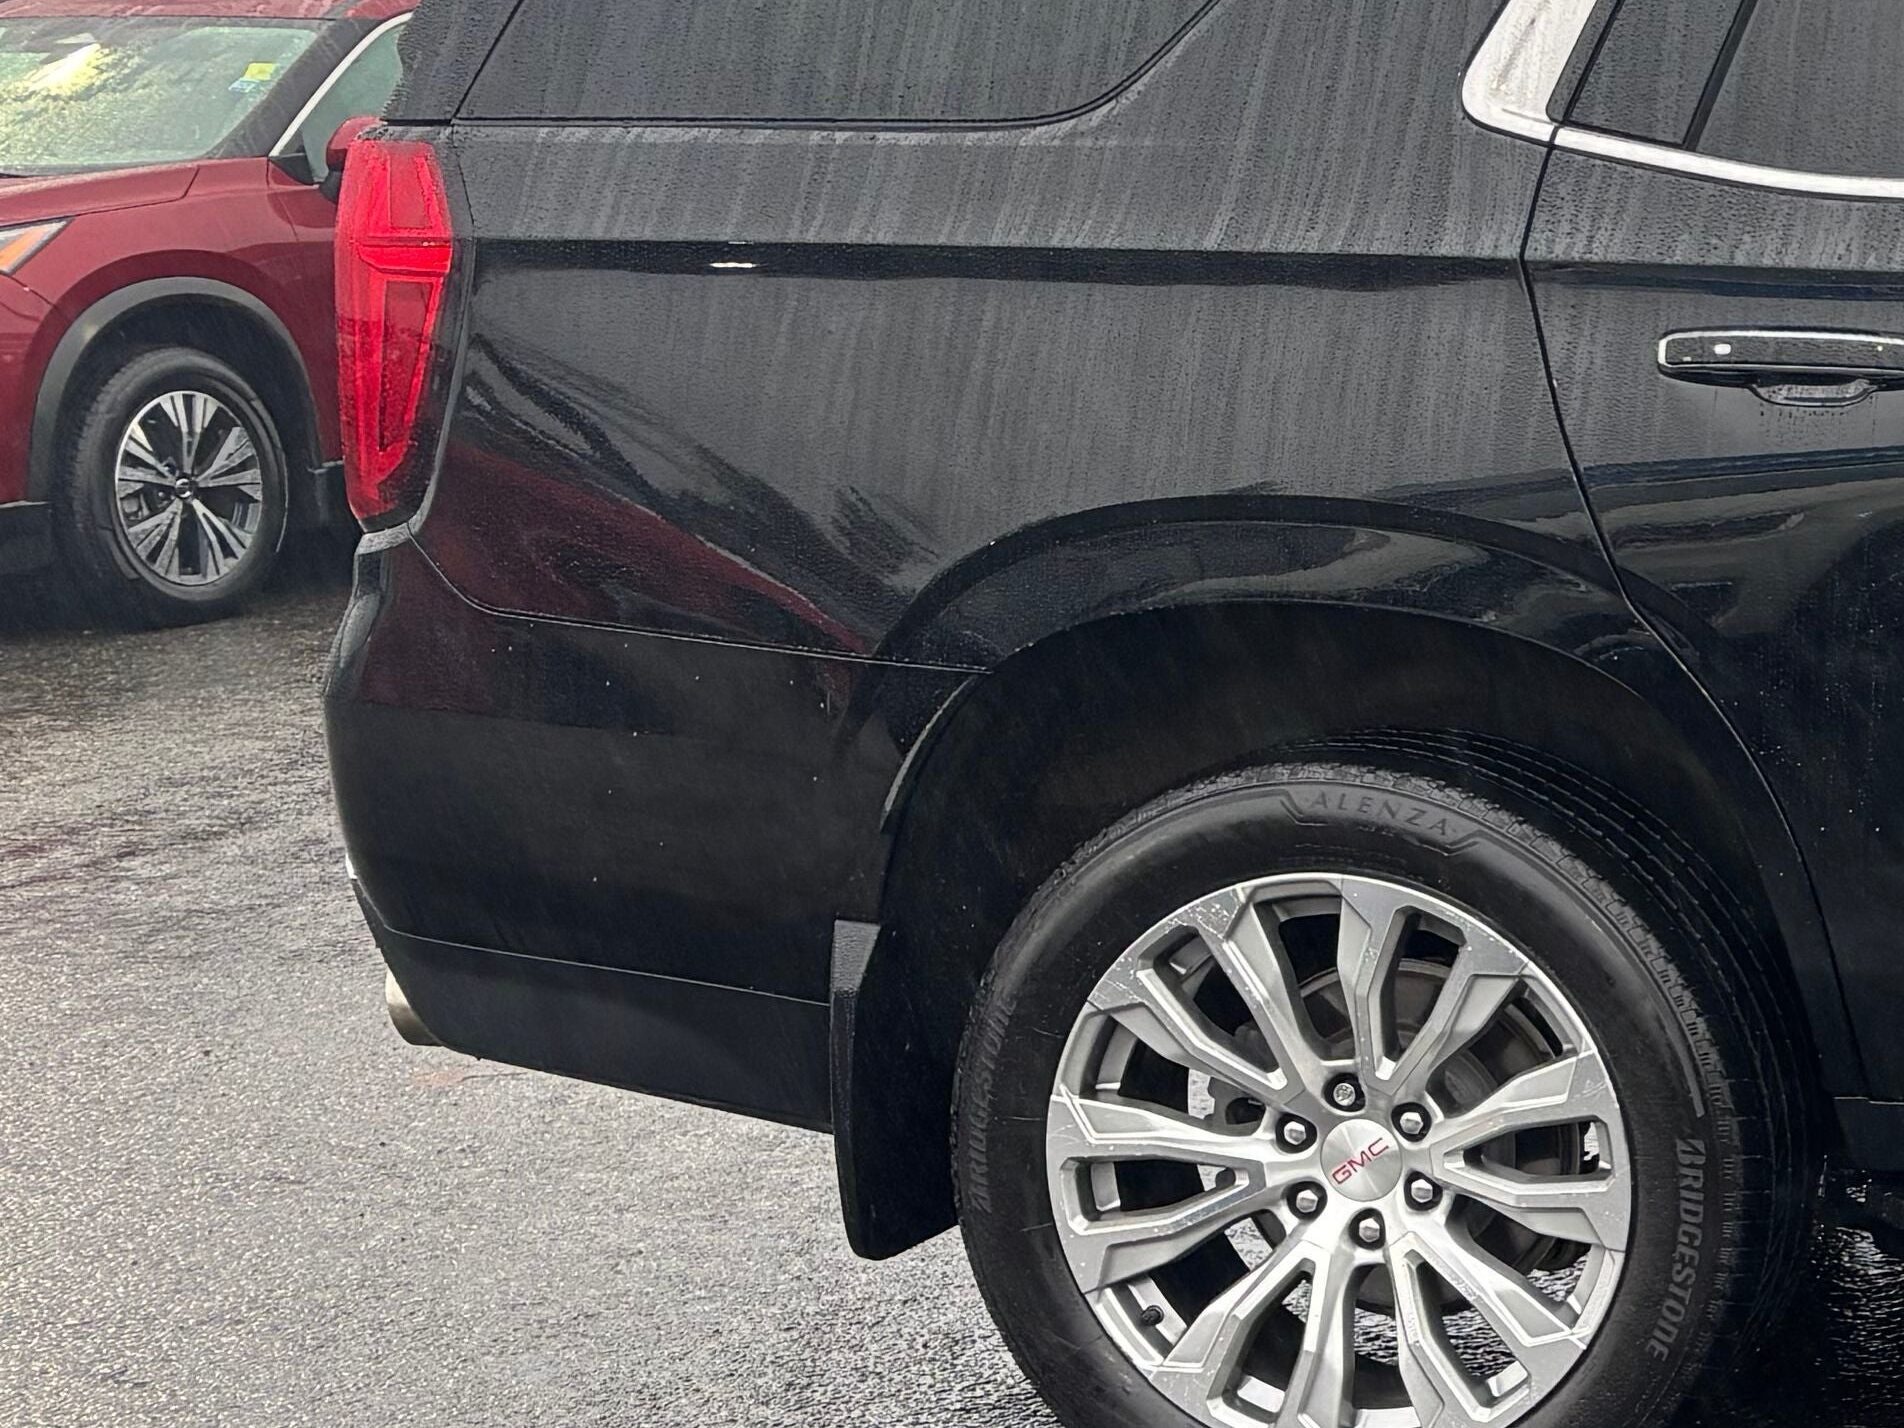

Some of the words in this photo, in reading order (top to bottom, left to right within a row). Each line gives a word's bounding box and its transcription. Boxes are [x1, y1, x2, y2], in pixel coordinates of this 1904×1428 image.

[1309, 791, 1448, 836] ALENZA
[1332, 1137, 1389, 1185] GMC
[1646, 1138, 1706, 1362] BRIDGESTONE
